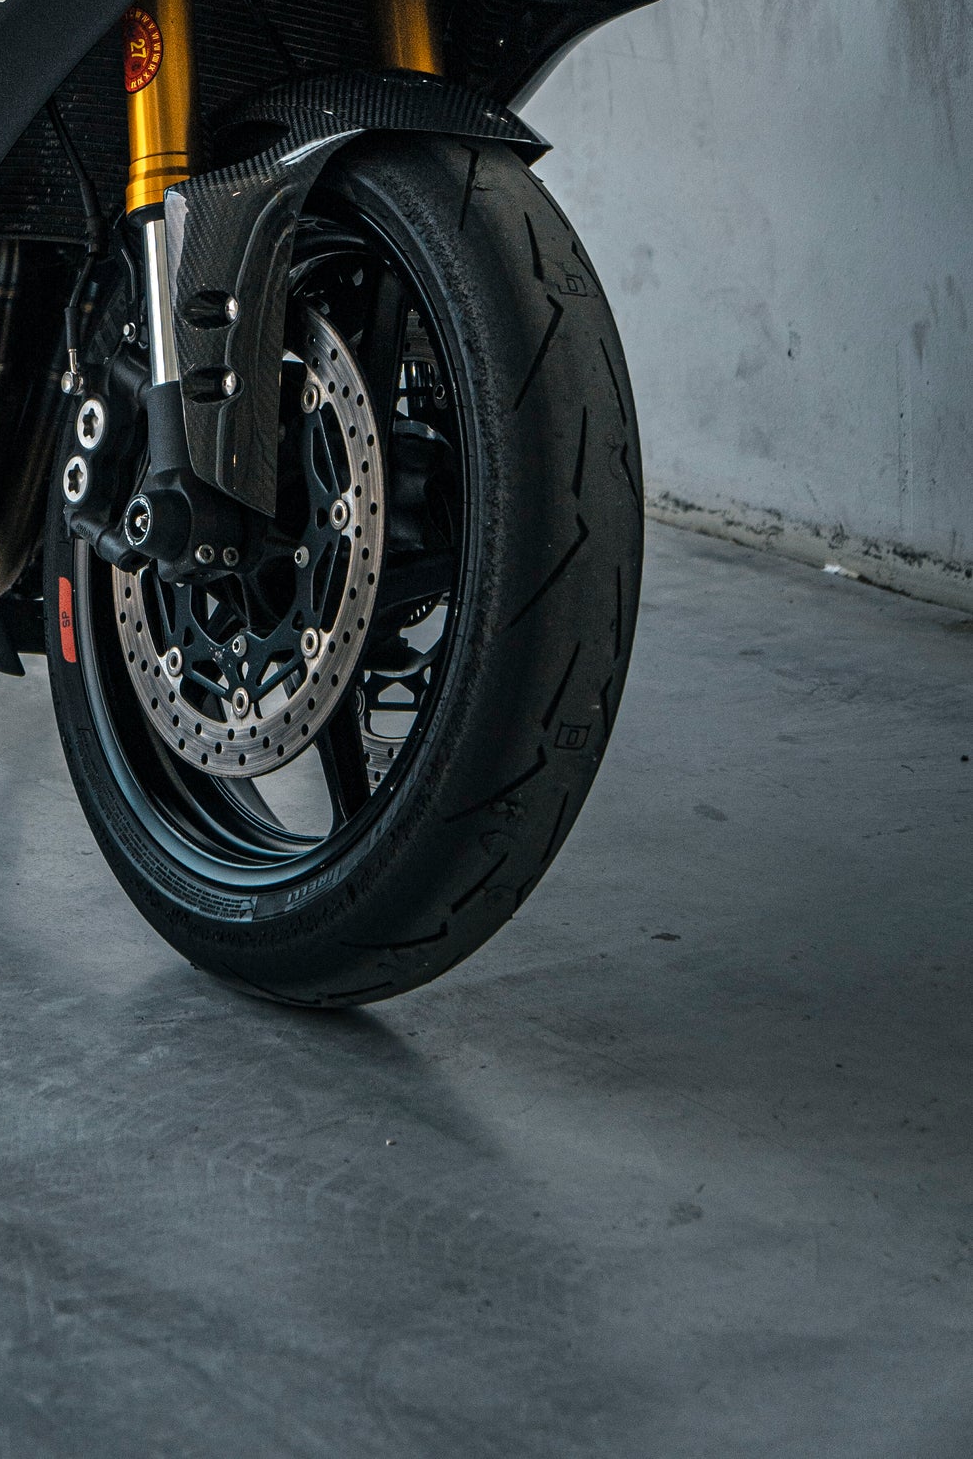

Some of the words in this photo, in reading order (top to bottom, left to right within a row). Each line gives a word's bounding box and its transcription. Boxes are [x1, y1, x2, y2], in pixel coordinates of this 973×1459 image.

[130, 38, 147, 58] 27
[61, 610, 71, 629] SP
[284, 864, 340, 912] PIRELLI
